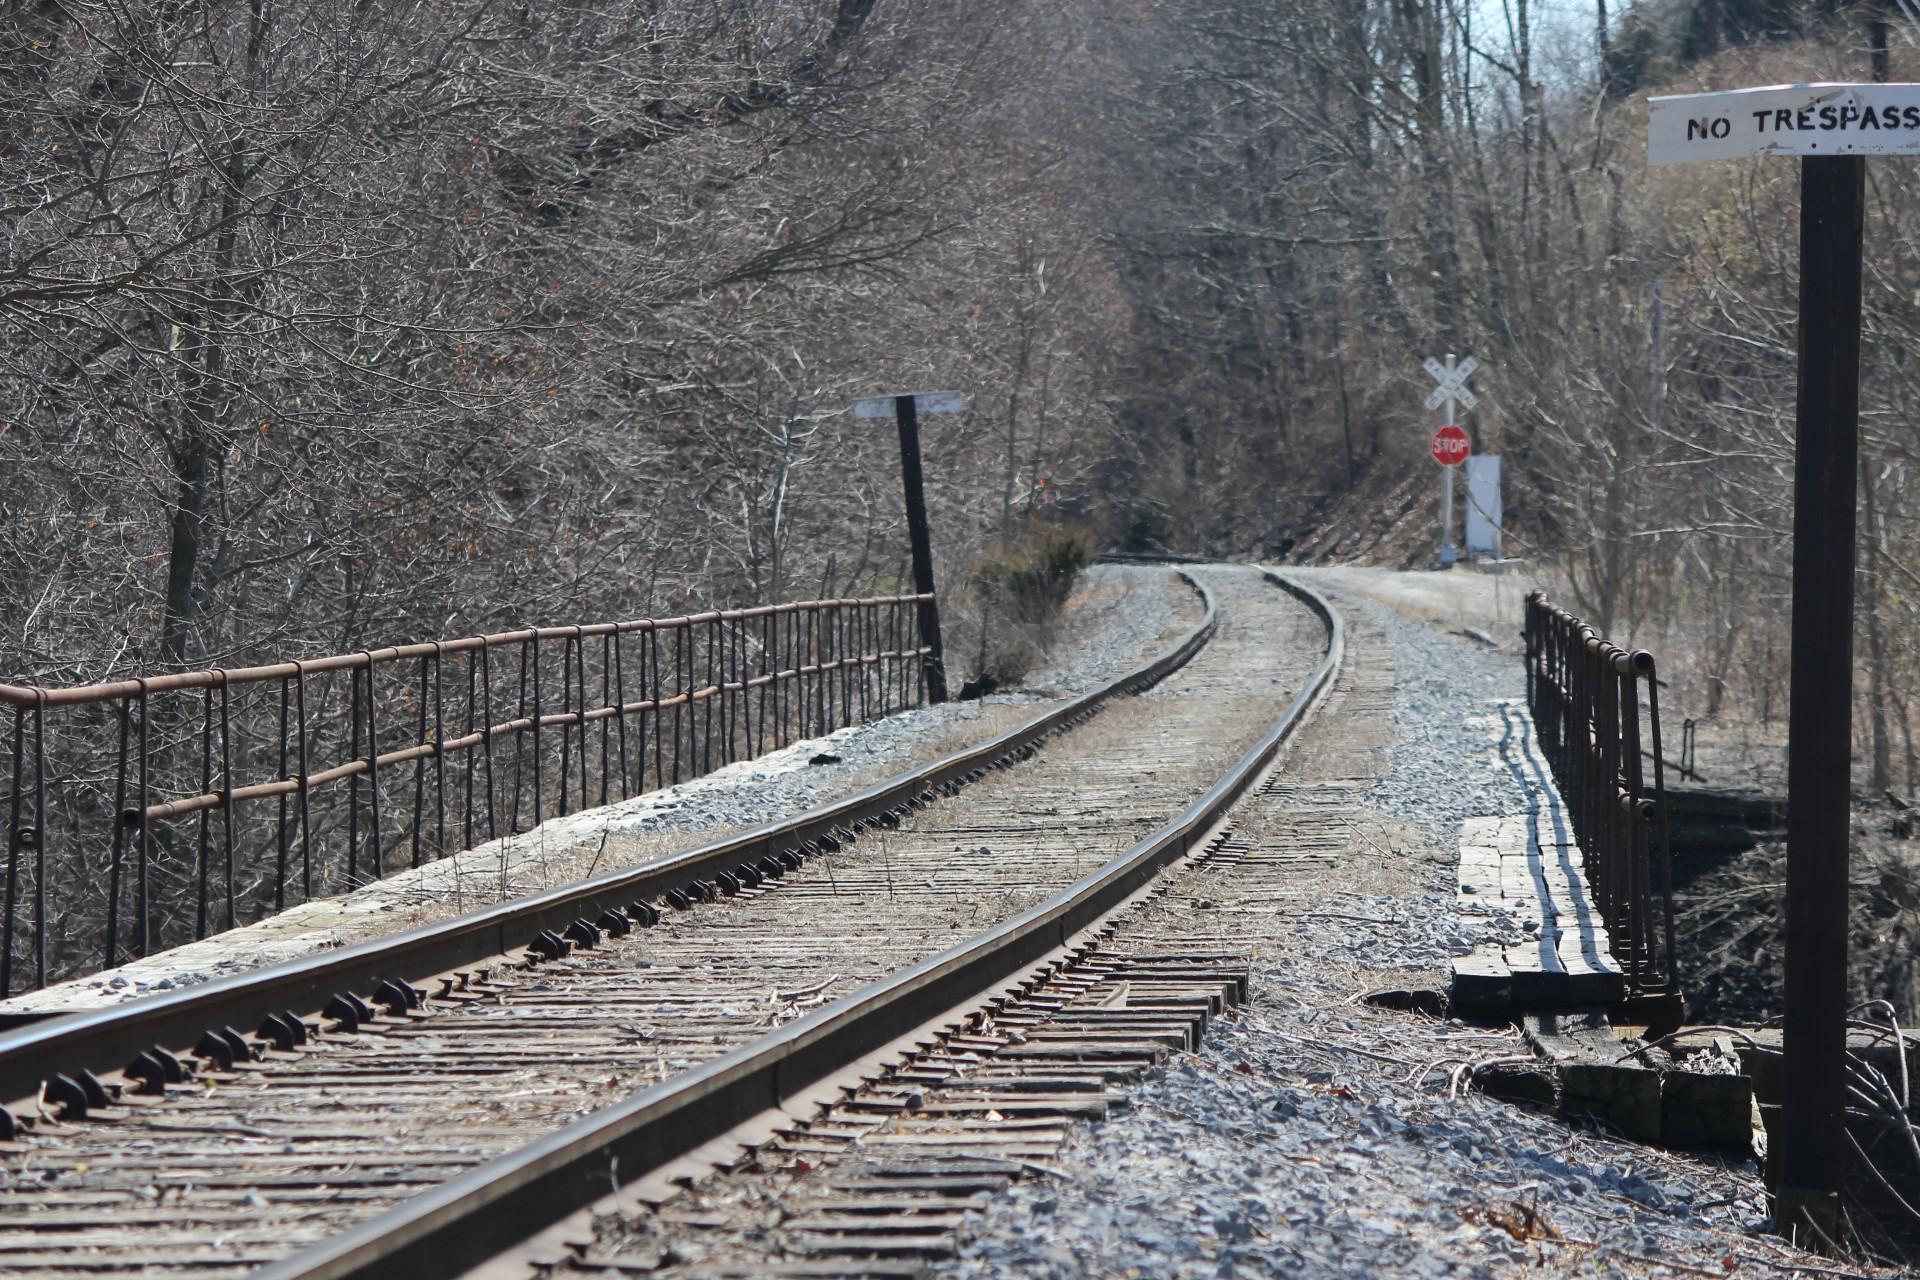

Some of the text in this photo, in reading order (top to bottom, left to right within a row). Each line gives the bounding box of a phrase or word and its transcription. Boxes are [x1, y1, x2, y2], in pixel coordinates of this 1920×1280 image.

[1687, 106, 1920, 141] NO TRESPASS
[1433, 438, 1468, 453] STOP
